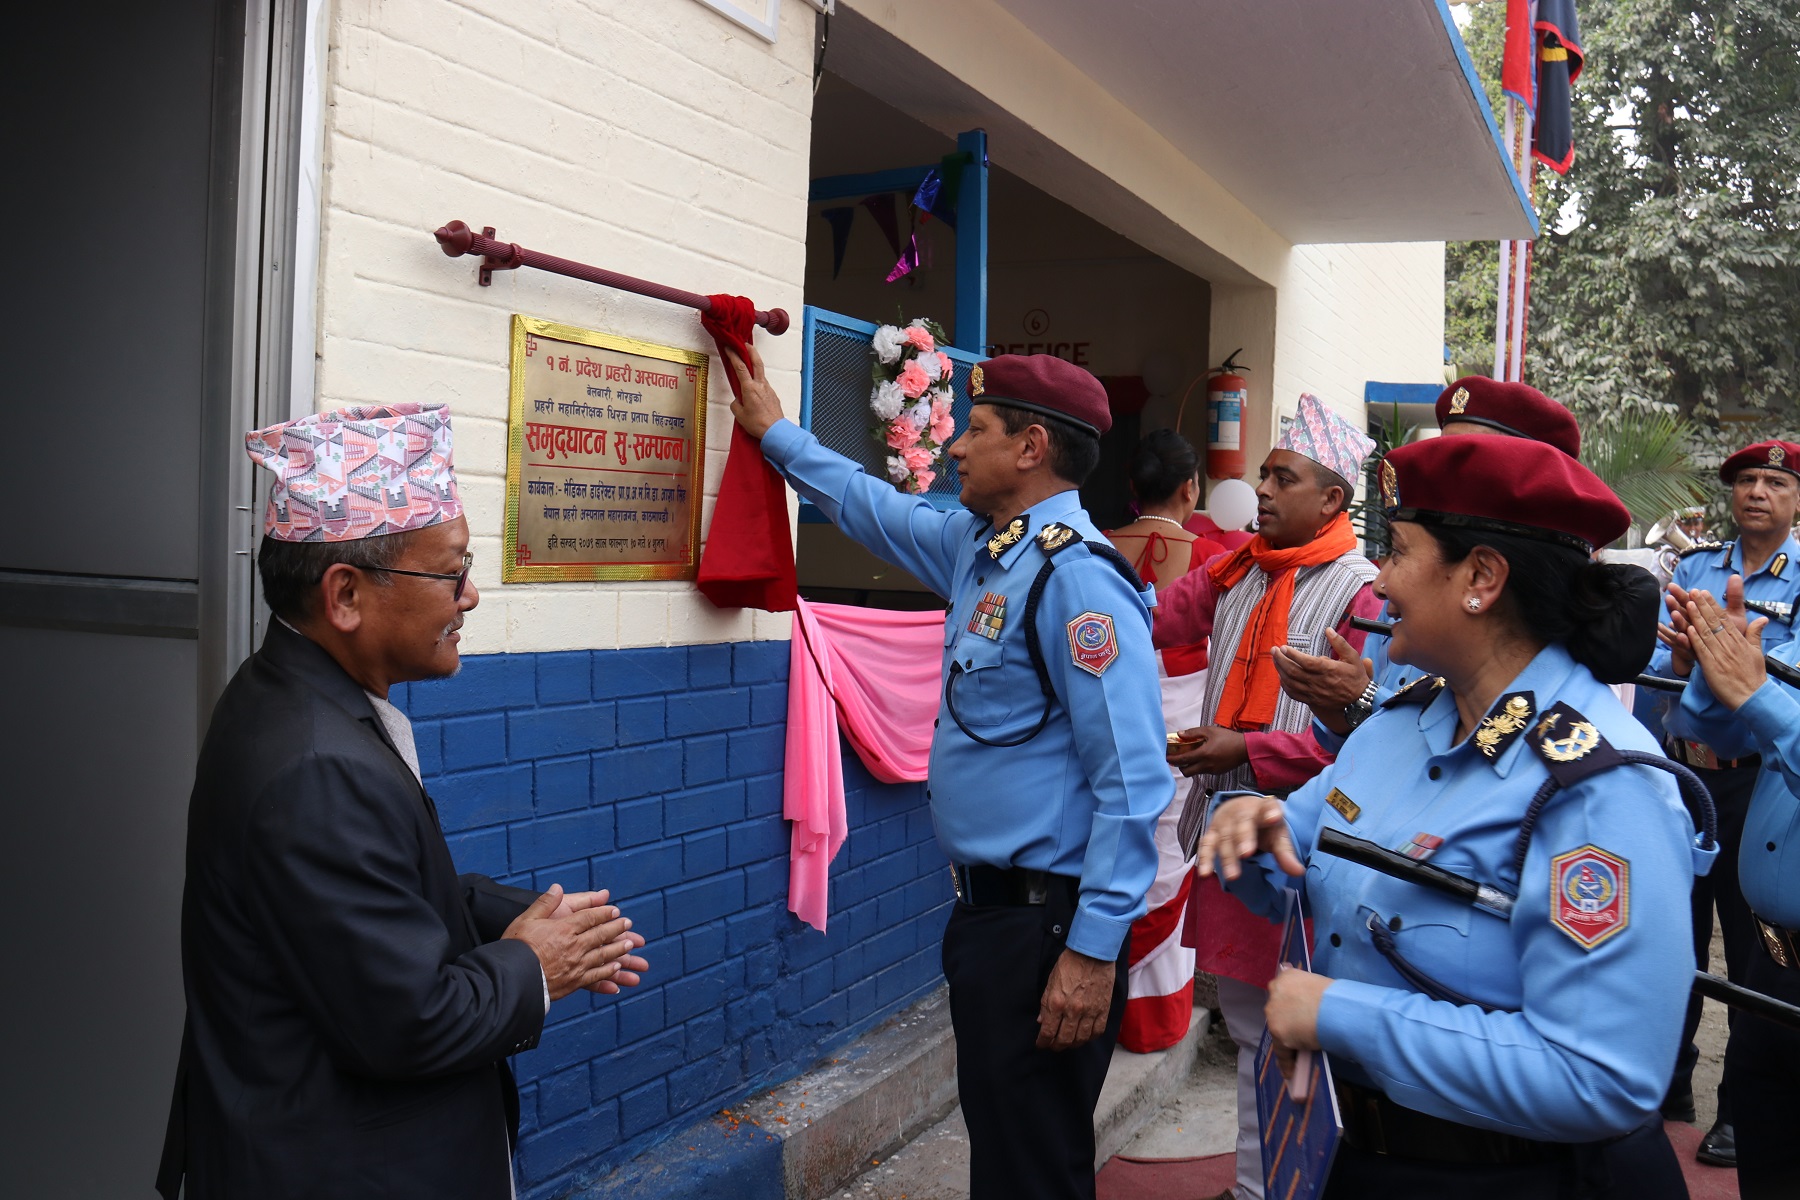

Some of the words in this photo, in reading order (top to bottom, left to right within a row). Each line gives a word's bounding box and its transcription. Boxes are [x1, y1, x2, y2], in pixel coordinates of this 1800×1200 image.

[547, 356, 553, 370] १
[559, 355, 571, 372] नं.
[576, 357, 602, 378] प्रदेश
[606, 362, 632, 382] प्रहरी
[635, 370, 678, 390] अस्पताल
[534, 397, 554, 413] प्रहरी
[558, 401, 603, 418] महानिरीक्षक
[607, 406, 628, 421] धिरज
[631, 412, 648, 424] प्रताप
[564, 478, 587, 498] मेडिकल
[544, 505, 560, 520] नेपाल
[562, 505, 577, 521] प्रहरी
[580, 509, 605, 521] अस्पताल
[548, 534, 558, 550] इति
[595, 537, 606, 548] साल
